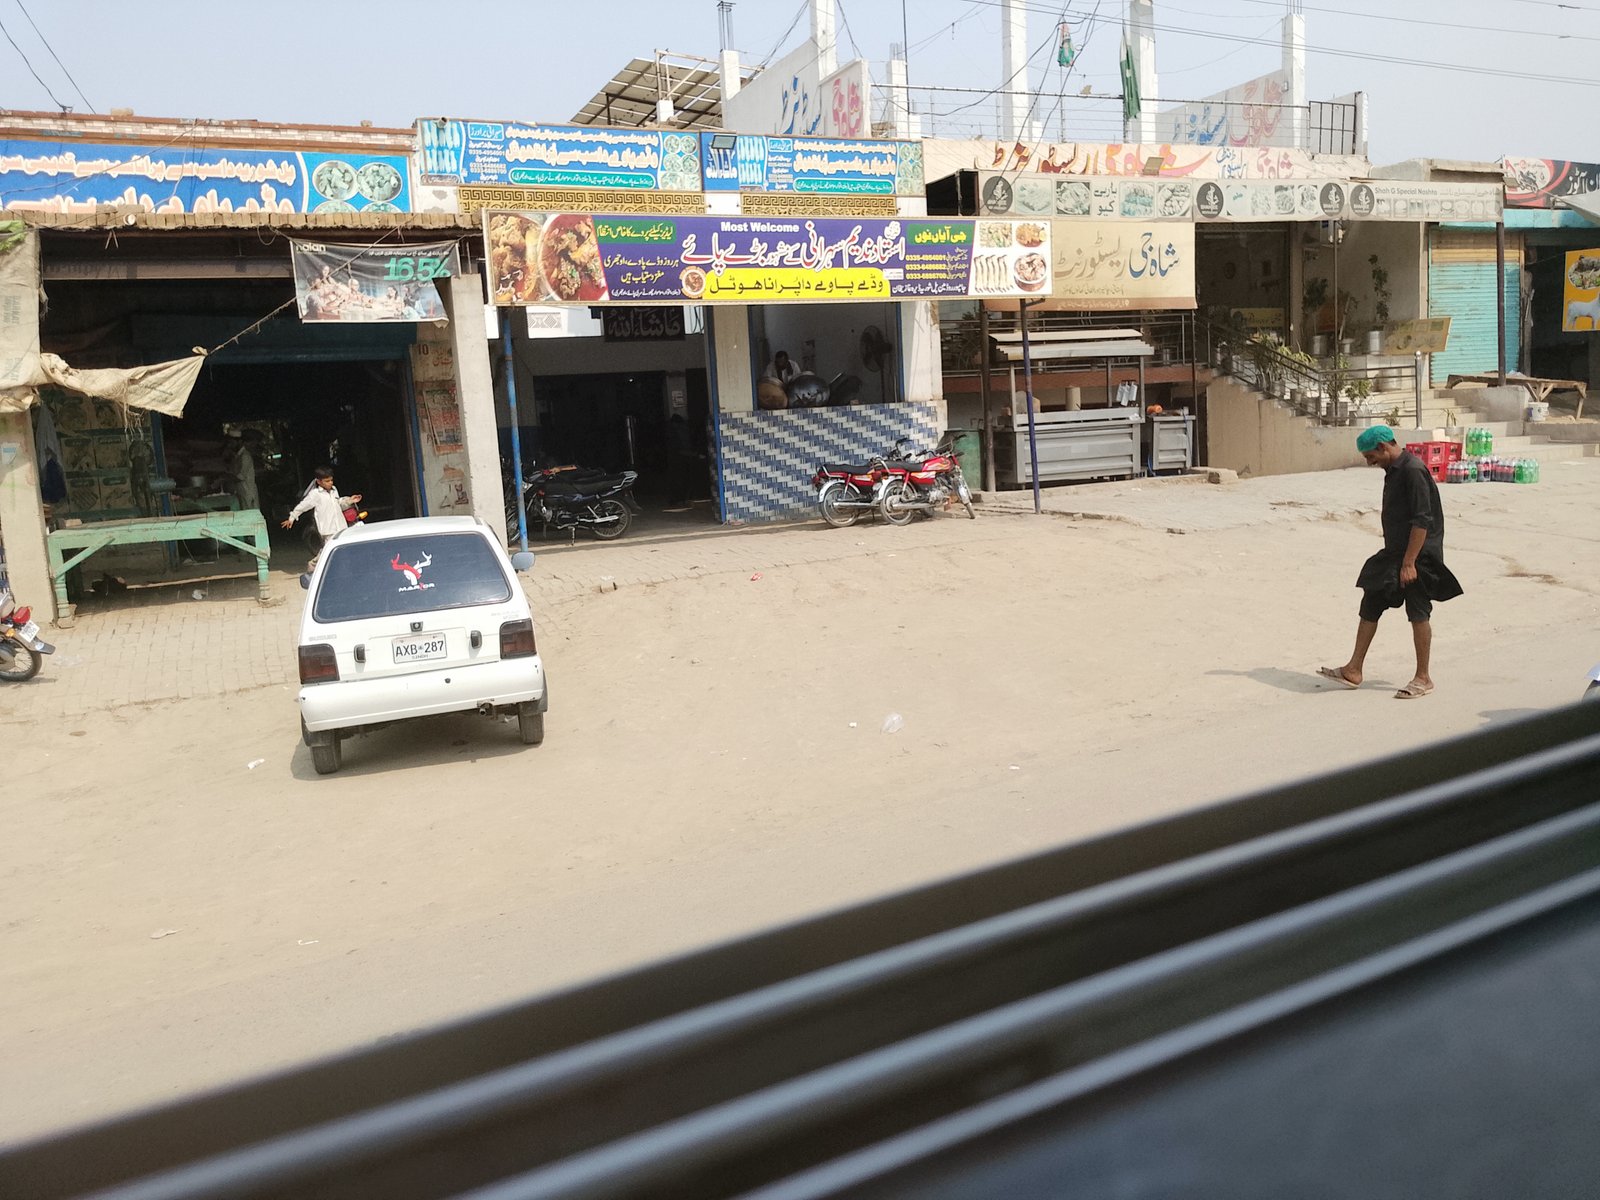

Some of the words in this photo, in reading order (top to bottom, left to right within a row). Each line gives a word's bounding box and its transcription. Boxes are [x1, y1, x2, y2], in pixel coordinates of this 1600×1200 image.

[721, 221, 748, 232] Most
[750, 222, 799, 233] Welcome
[914, 228, 932, 243] نوں
[951, 231, 967, 243] جی
[680, 232, 727, 276] پائے
[1129, 232, 1154, 279] جی
[1149, 241, 1180, 278] شاہ
[620, 272, 632, 285] ہیں
[396, 644, 418, 658] AXB
[424, 640, 444, 654] 287
